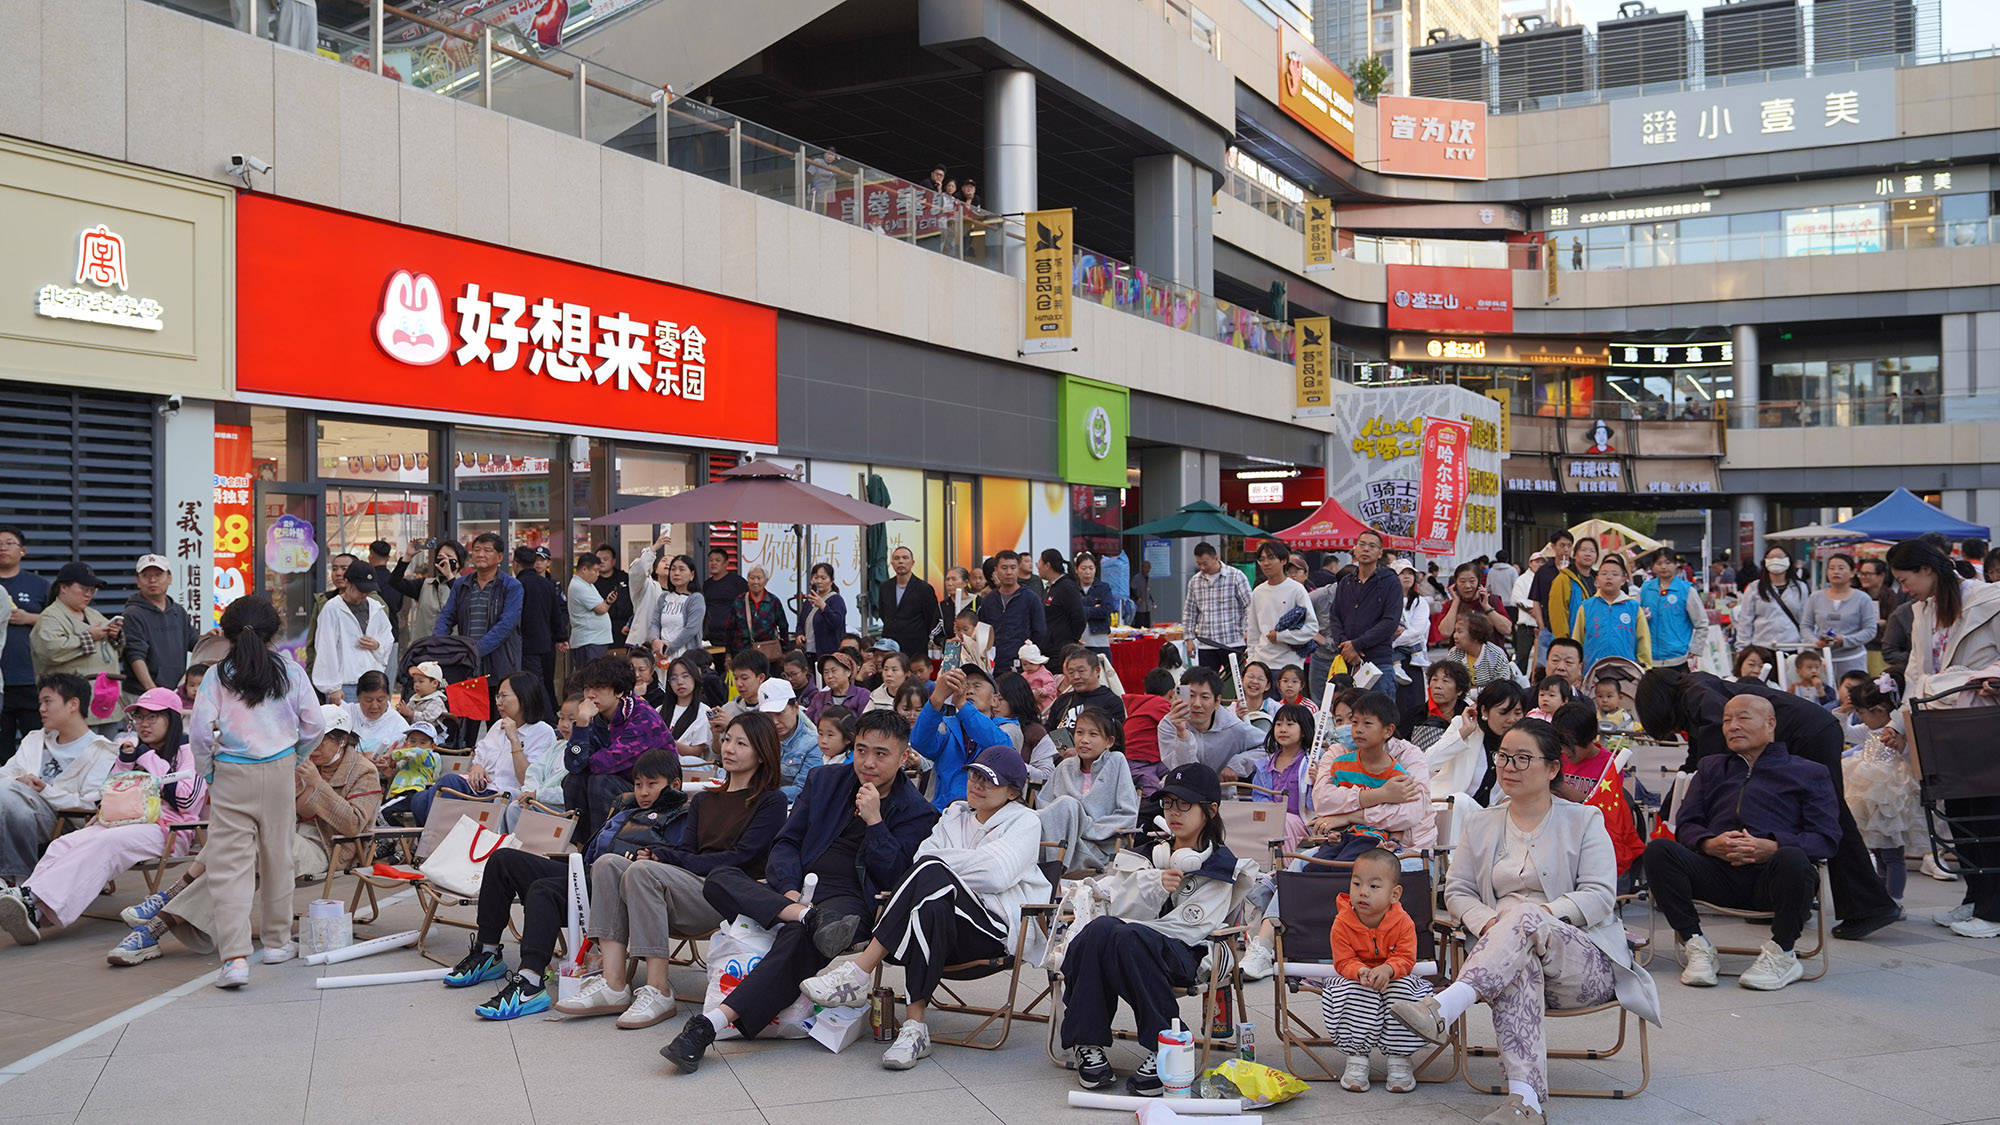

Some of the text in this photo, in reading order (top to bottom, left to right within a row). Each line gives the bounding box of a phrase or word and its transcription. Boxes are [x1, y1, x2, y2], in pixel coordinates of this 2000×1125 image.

[1391, 115, 1475, 145] 音为欢
[1643, 110, 1677, 123] XIA
[1643, 120, 1677, 134] OYI
[1698, 91, 1860, 139] 小壹美
[1444, 147, 1475, 161] KTV
[454, 283, 653, 392] 好想来
[654, 320, 707, 365] 零食
[654, 361, 706, 401] 乐园
[1372, 482, 1417, 498] 骑士
[1430, 445, 1454, 540] 哈尔滨红肠
[177, 500, 204, 560] 義利
